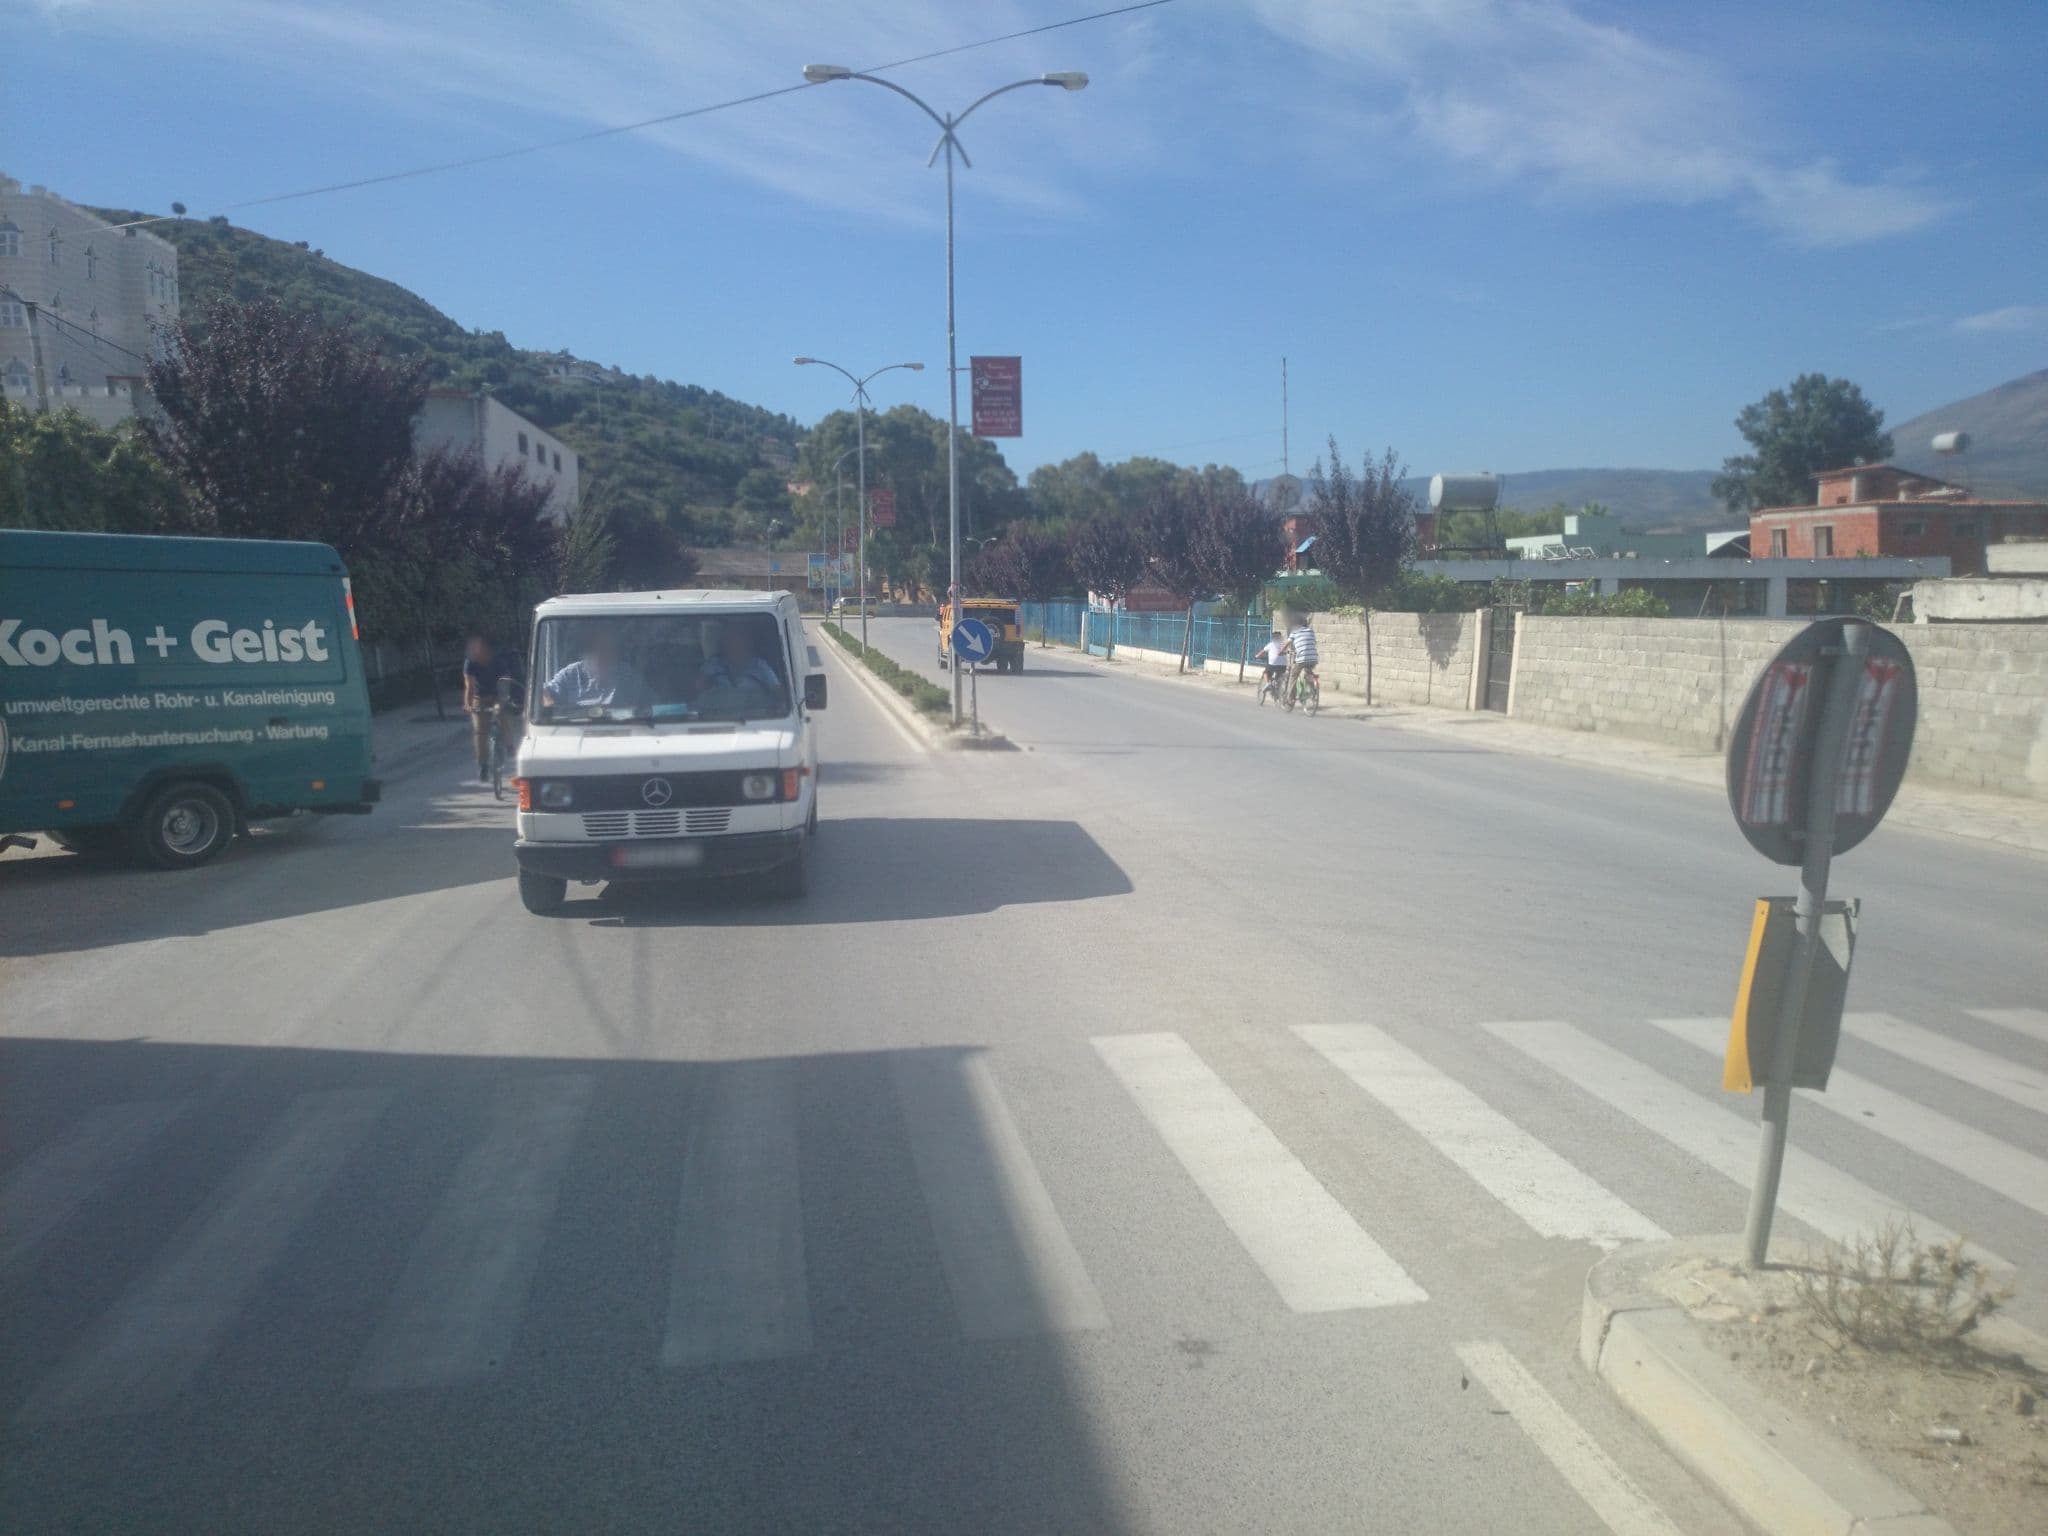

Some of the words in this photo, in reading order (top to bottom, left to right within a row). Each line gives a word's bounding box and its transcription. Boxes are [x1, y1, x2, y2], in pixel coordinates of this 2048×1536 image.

[146, 625, 178, 657] +
[190, 619, 329, 664] Geist
[5, 694, 150, 715] umweltgerechte
[155, 693, 200, 708] Rohr-
[205, 695, 219, 707] u.
[223, 690, 335, 706] Kanalreinigung
[12, 729, 254, 752] Kanal-Fernsehuntersuchung
[266, 725, 328, 742] Wartung
